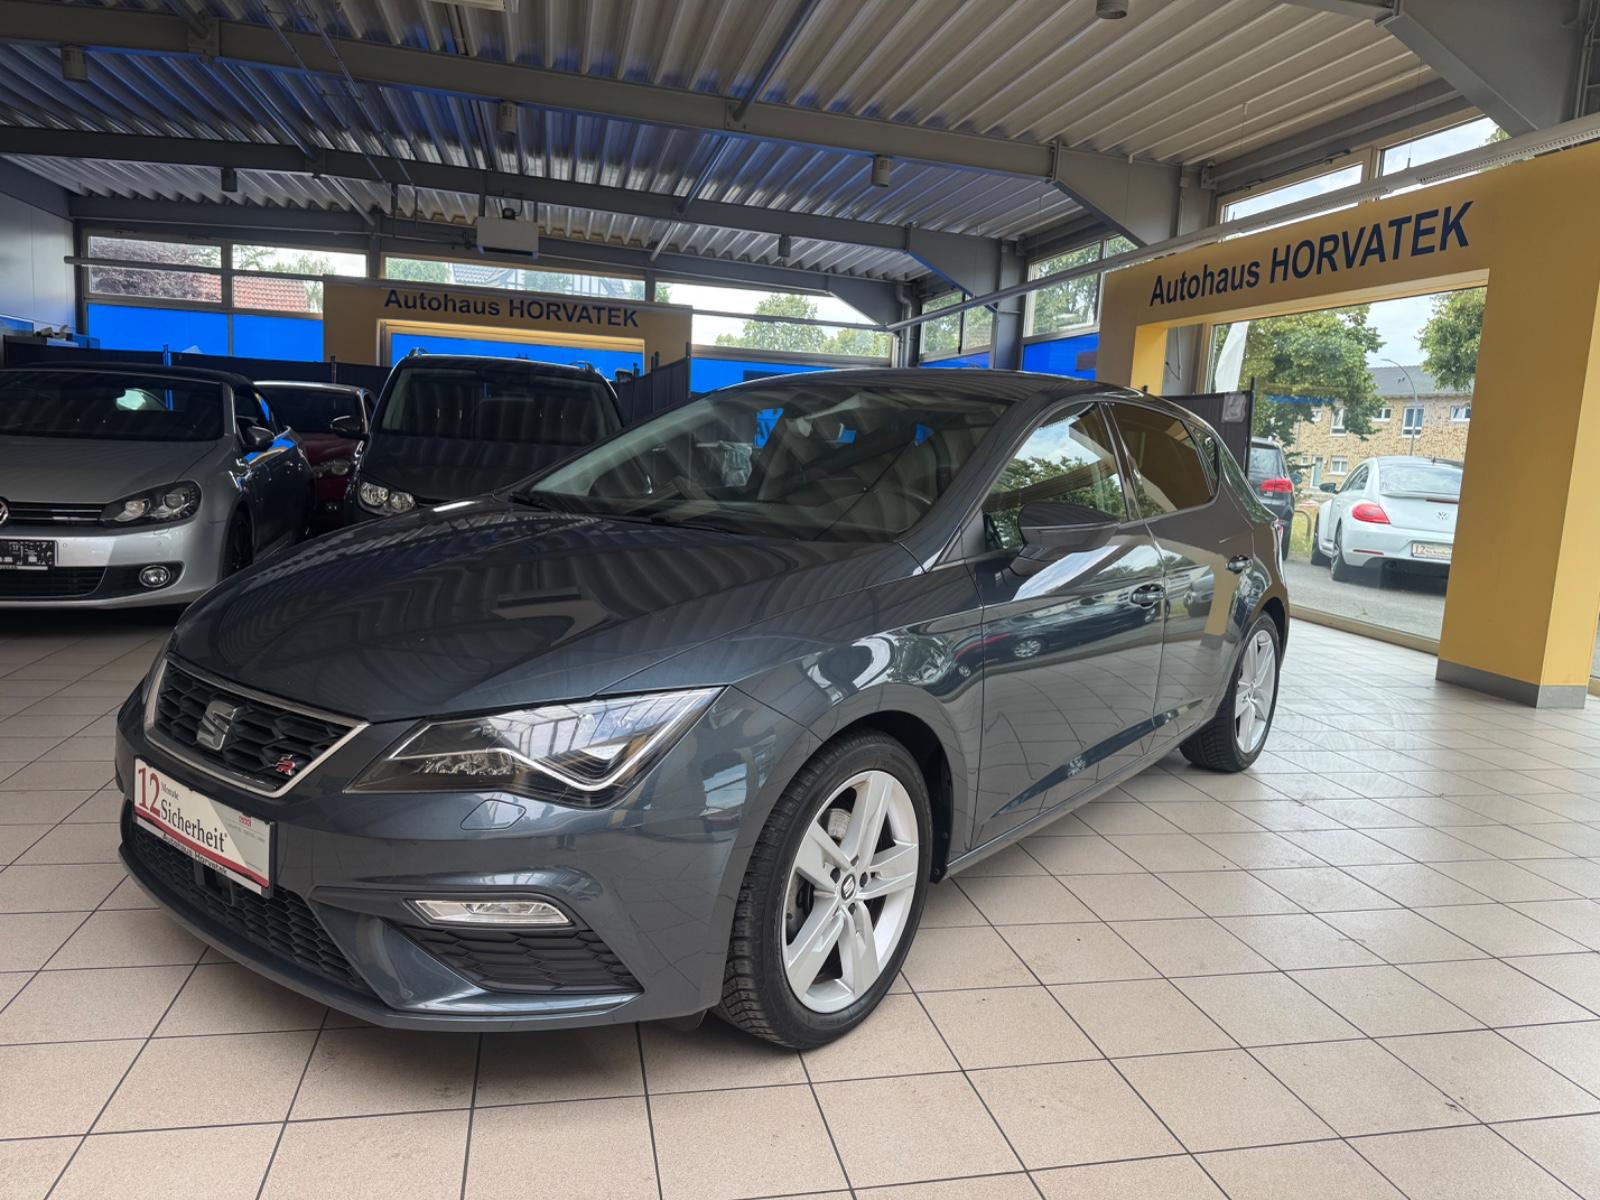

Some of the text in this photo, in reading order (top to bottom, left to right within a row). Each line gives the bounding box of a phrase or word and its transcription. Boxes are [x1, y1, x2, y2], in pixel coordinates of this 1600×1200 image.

[1150, 200, 1474, 306] Autohaus HORVATEK
[384, 288, 640, 328] Autohaus HORVATEK
[138, 767, 161, 818] 12
